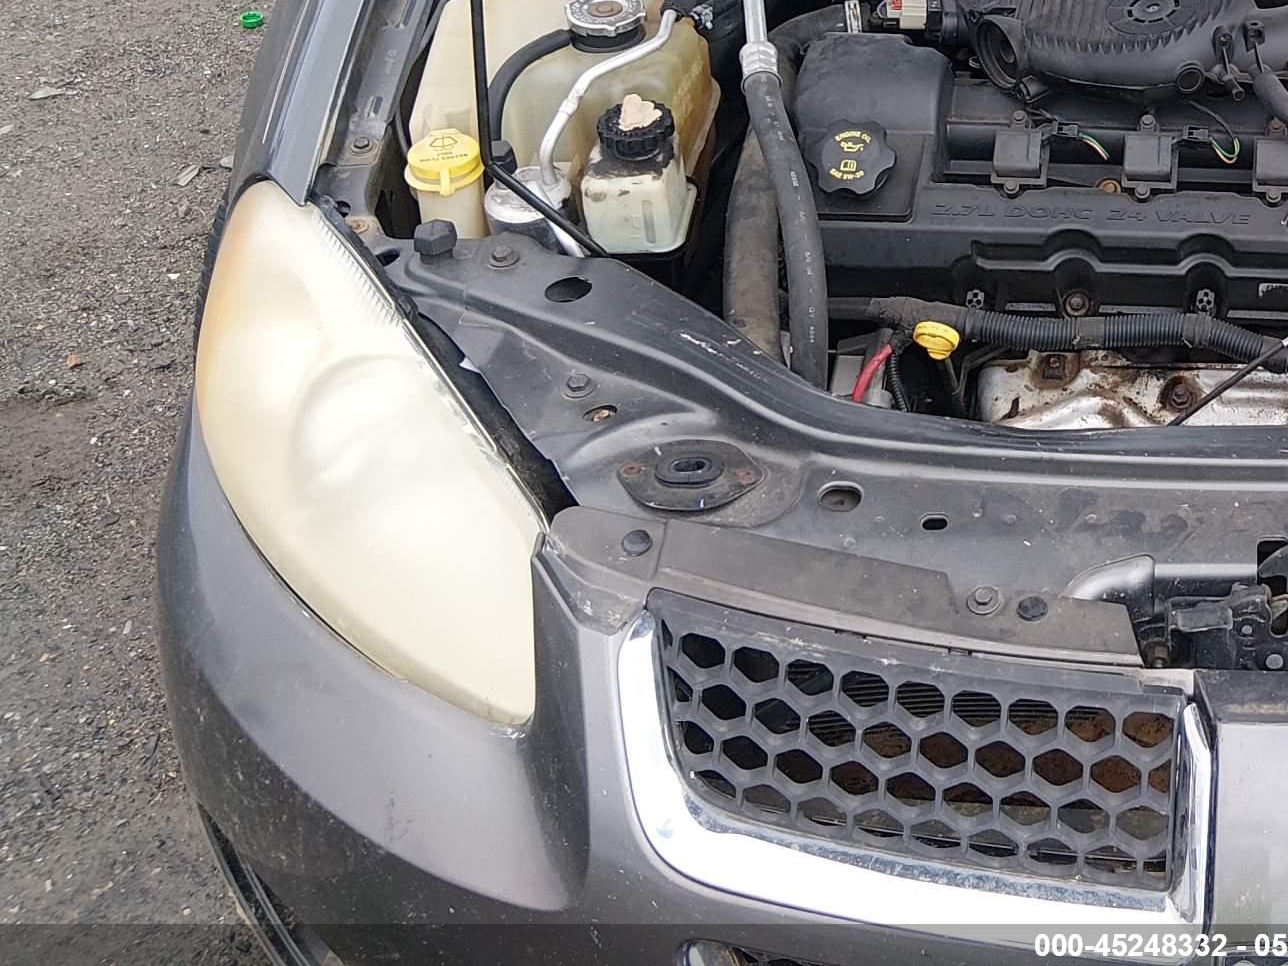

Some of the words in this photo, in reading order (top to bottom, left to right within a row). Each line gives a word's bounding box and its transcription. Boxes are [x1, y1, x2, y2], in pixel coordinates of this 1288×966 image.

[834, 130, 861, 141] ENGINE
[861, 133, 872, 144] OIL
[829, 168, 841, 179] SAE
[931, 203, 995, 217] 2.7L
[1004, 205, 1093, 220] DOHC
[1107, 209, 1148, 222] 24
[1155, 210, 1251, 225] VALVE
